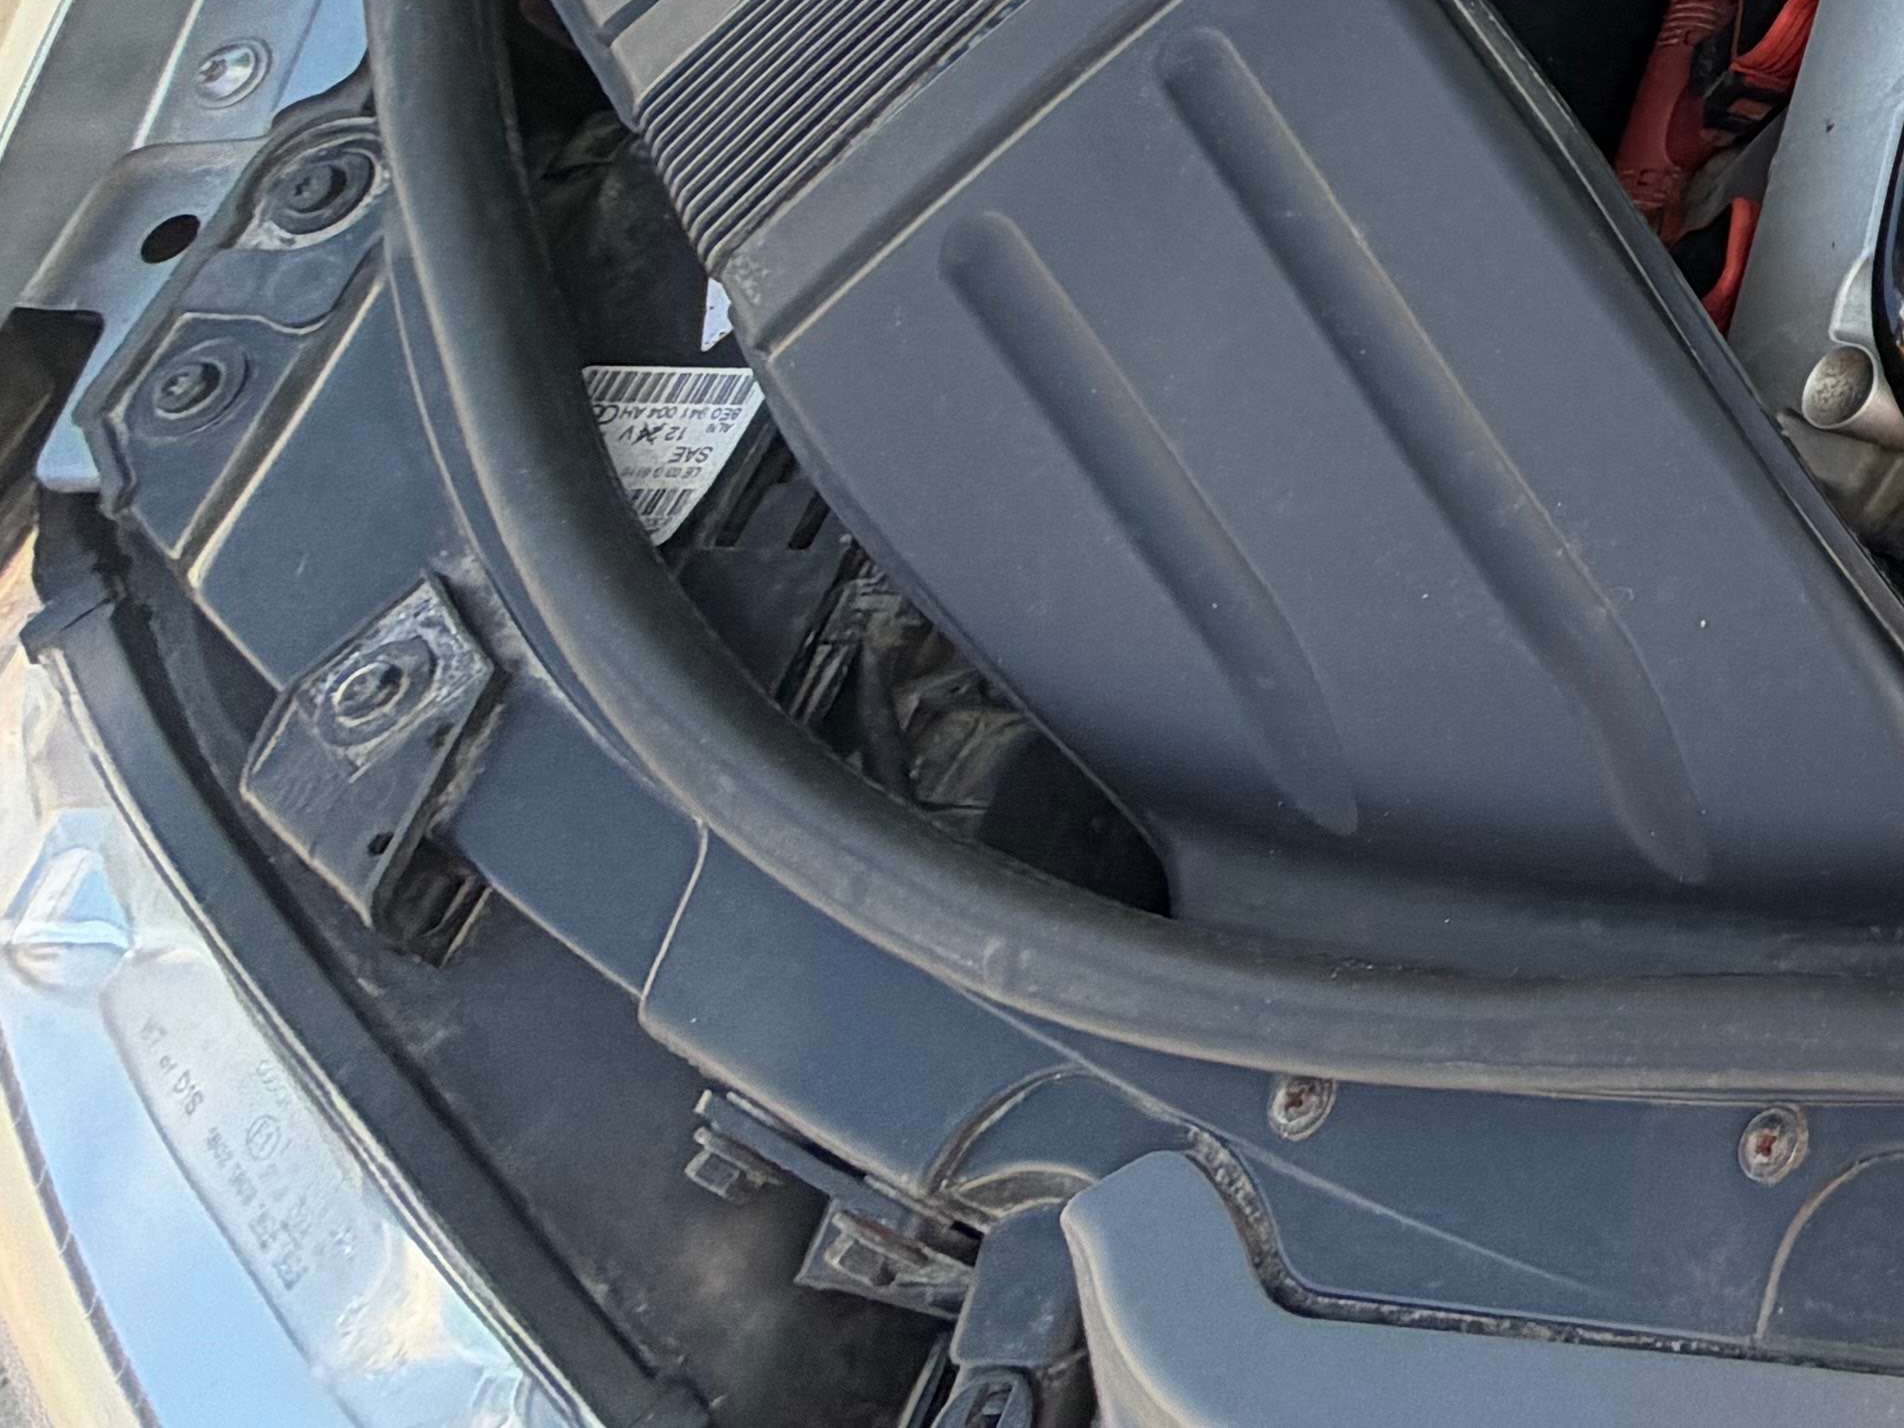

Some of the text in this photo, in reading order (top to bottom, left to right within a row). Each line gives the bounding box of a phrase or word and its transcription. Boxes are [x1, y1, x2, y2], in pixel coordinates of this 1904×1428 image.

[617, 425, 635, 442] V
[664, 425, 689, 442] 12
[667, 446, 714, 464] SAE
